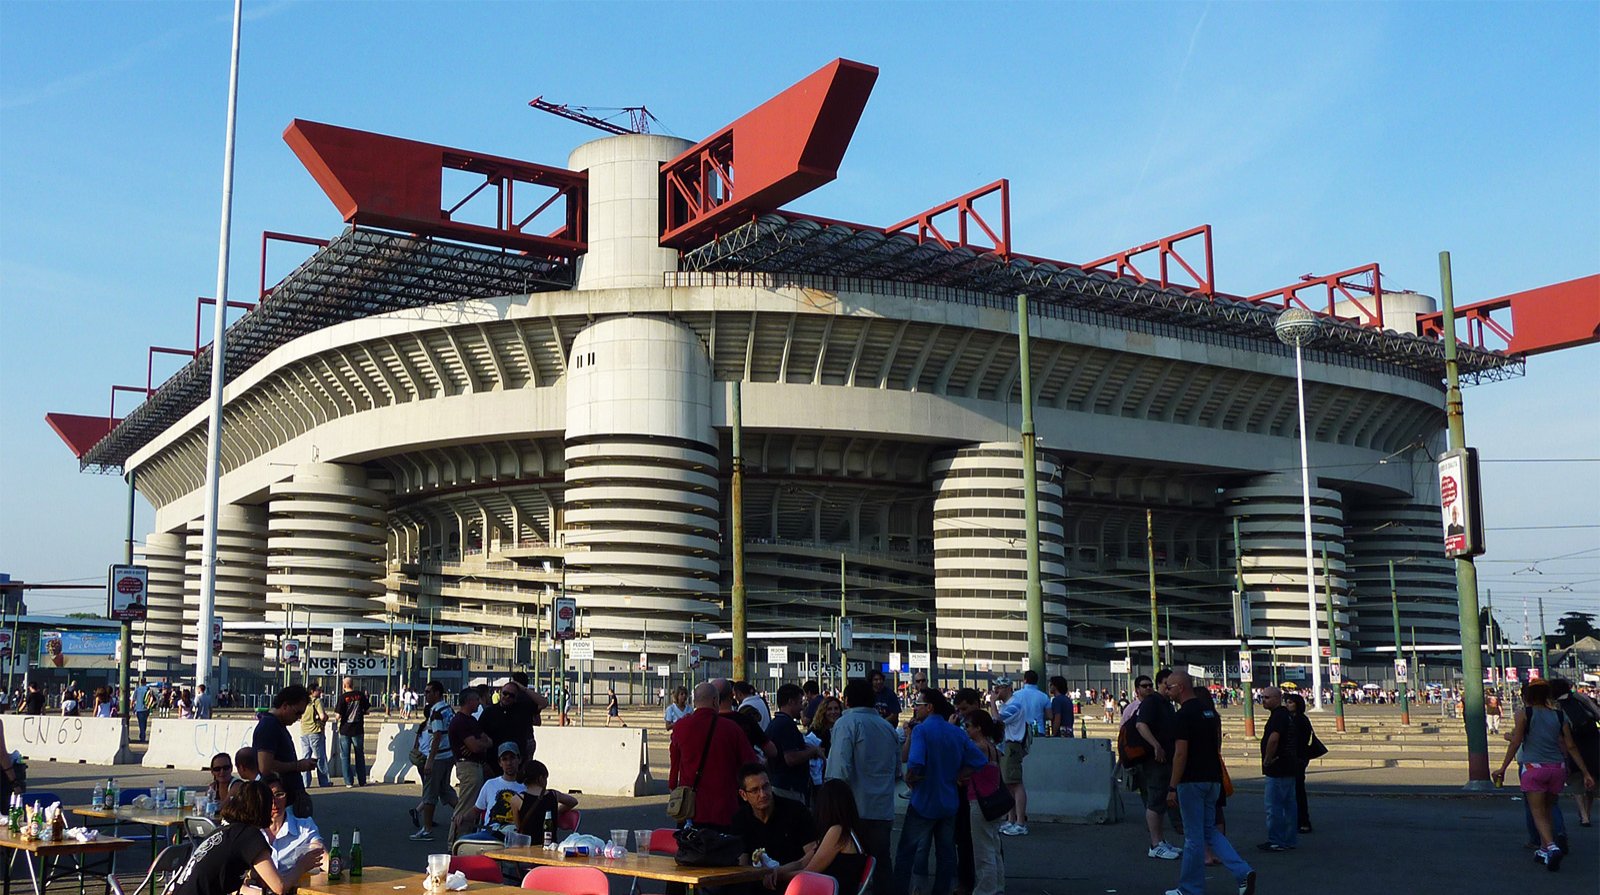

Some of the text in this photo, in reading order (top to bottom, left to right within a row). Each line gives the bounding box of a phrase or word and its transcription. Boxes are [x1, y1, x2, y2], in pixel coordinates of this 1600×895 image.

[380, 657, 396, 669] 12
[853, 662, 864, 672] 13
[23, 716, 82, 745] CN 69
